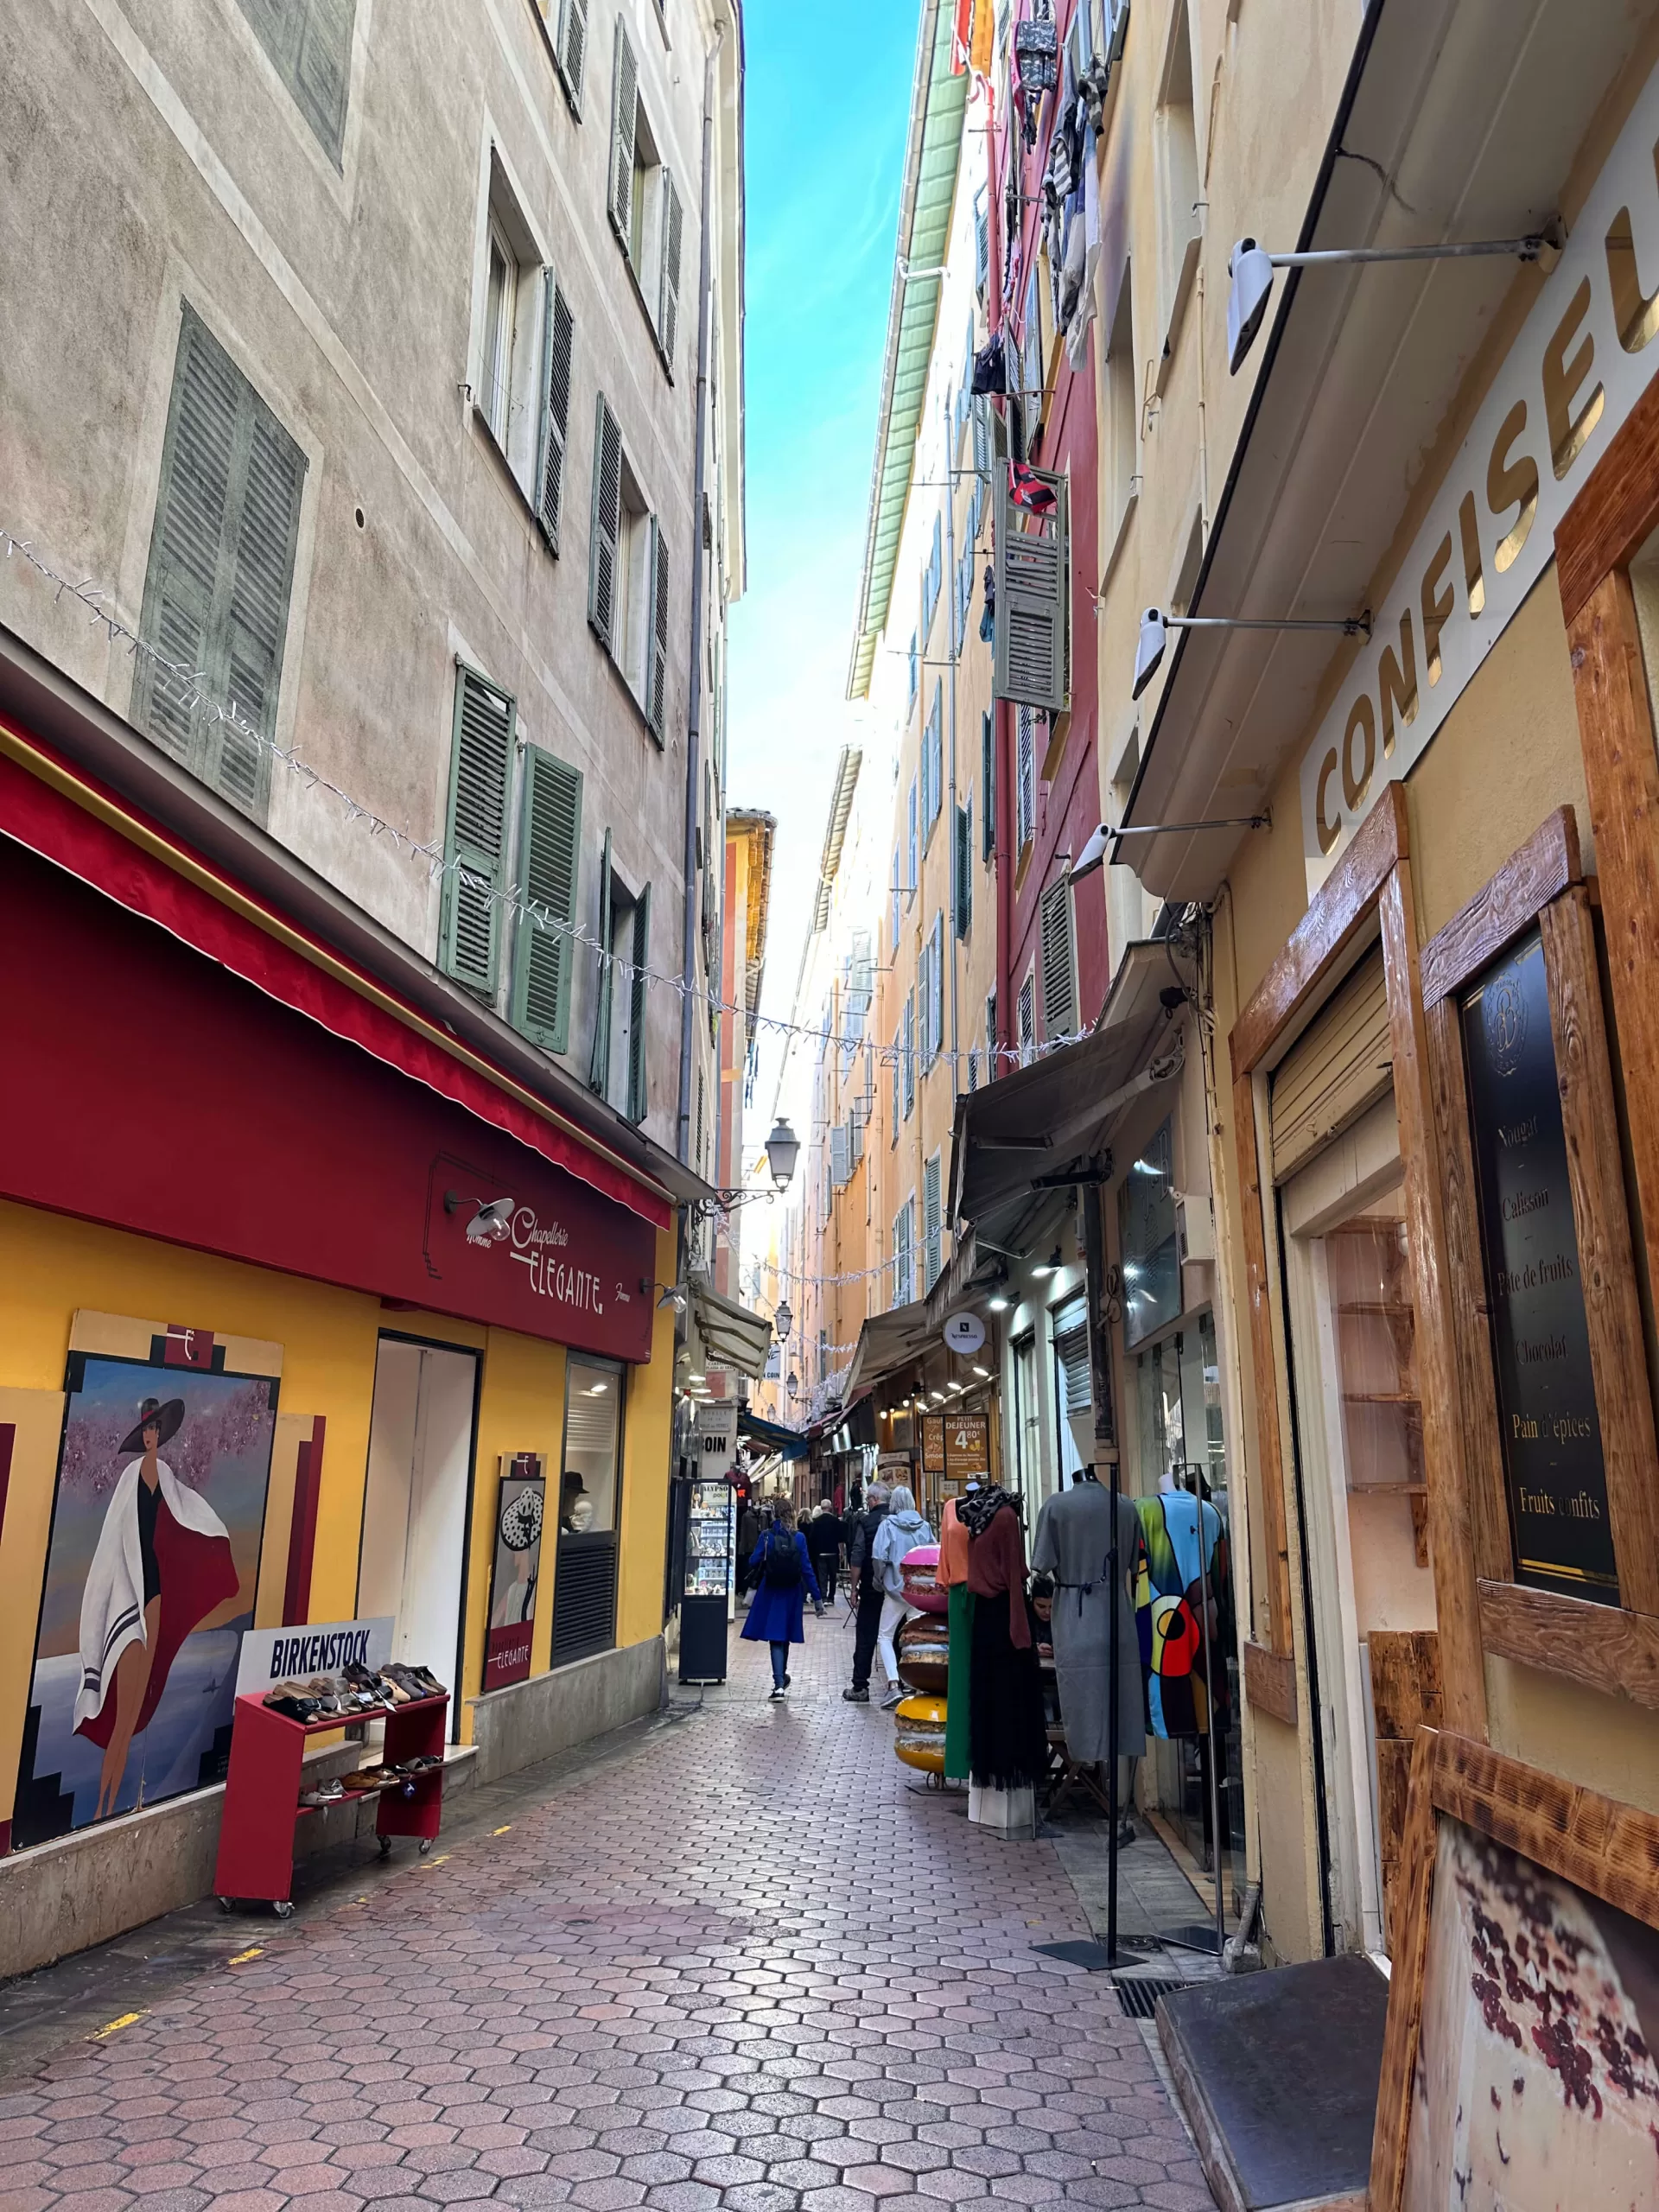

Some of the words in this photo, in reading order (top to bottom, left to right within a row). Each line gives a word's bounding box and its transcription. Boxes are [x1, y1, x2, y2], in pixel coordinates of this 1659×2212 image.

[1497, 1112, 1539, 1148] Nougat
[1503, 1185, 1549, 1222] Calisson
[512, 1206, 569, 1252] Chapellerie
[510, 1250, 603, 1315] ELEGANTE
[1522, 1263, 1538, 1290] de
[1538, 1251, 1574, 1286] fruits
[1516, 1333, 1569, 1366] Chocolat
[702, 1436, 726, 1452] OIN
[1512, 1412, 1539, 1440] Pain
[1519, 1486, 1556, 1516] Fruits
[1559, 1489, 1600, 1520] confits
[270, 1630, 371, 1679] BIRKENSTOCK
[487, 1644, 530, 1669] ELEGANTE
